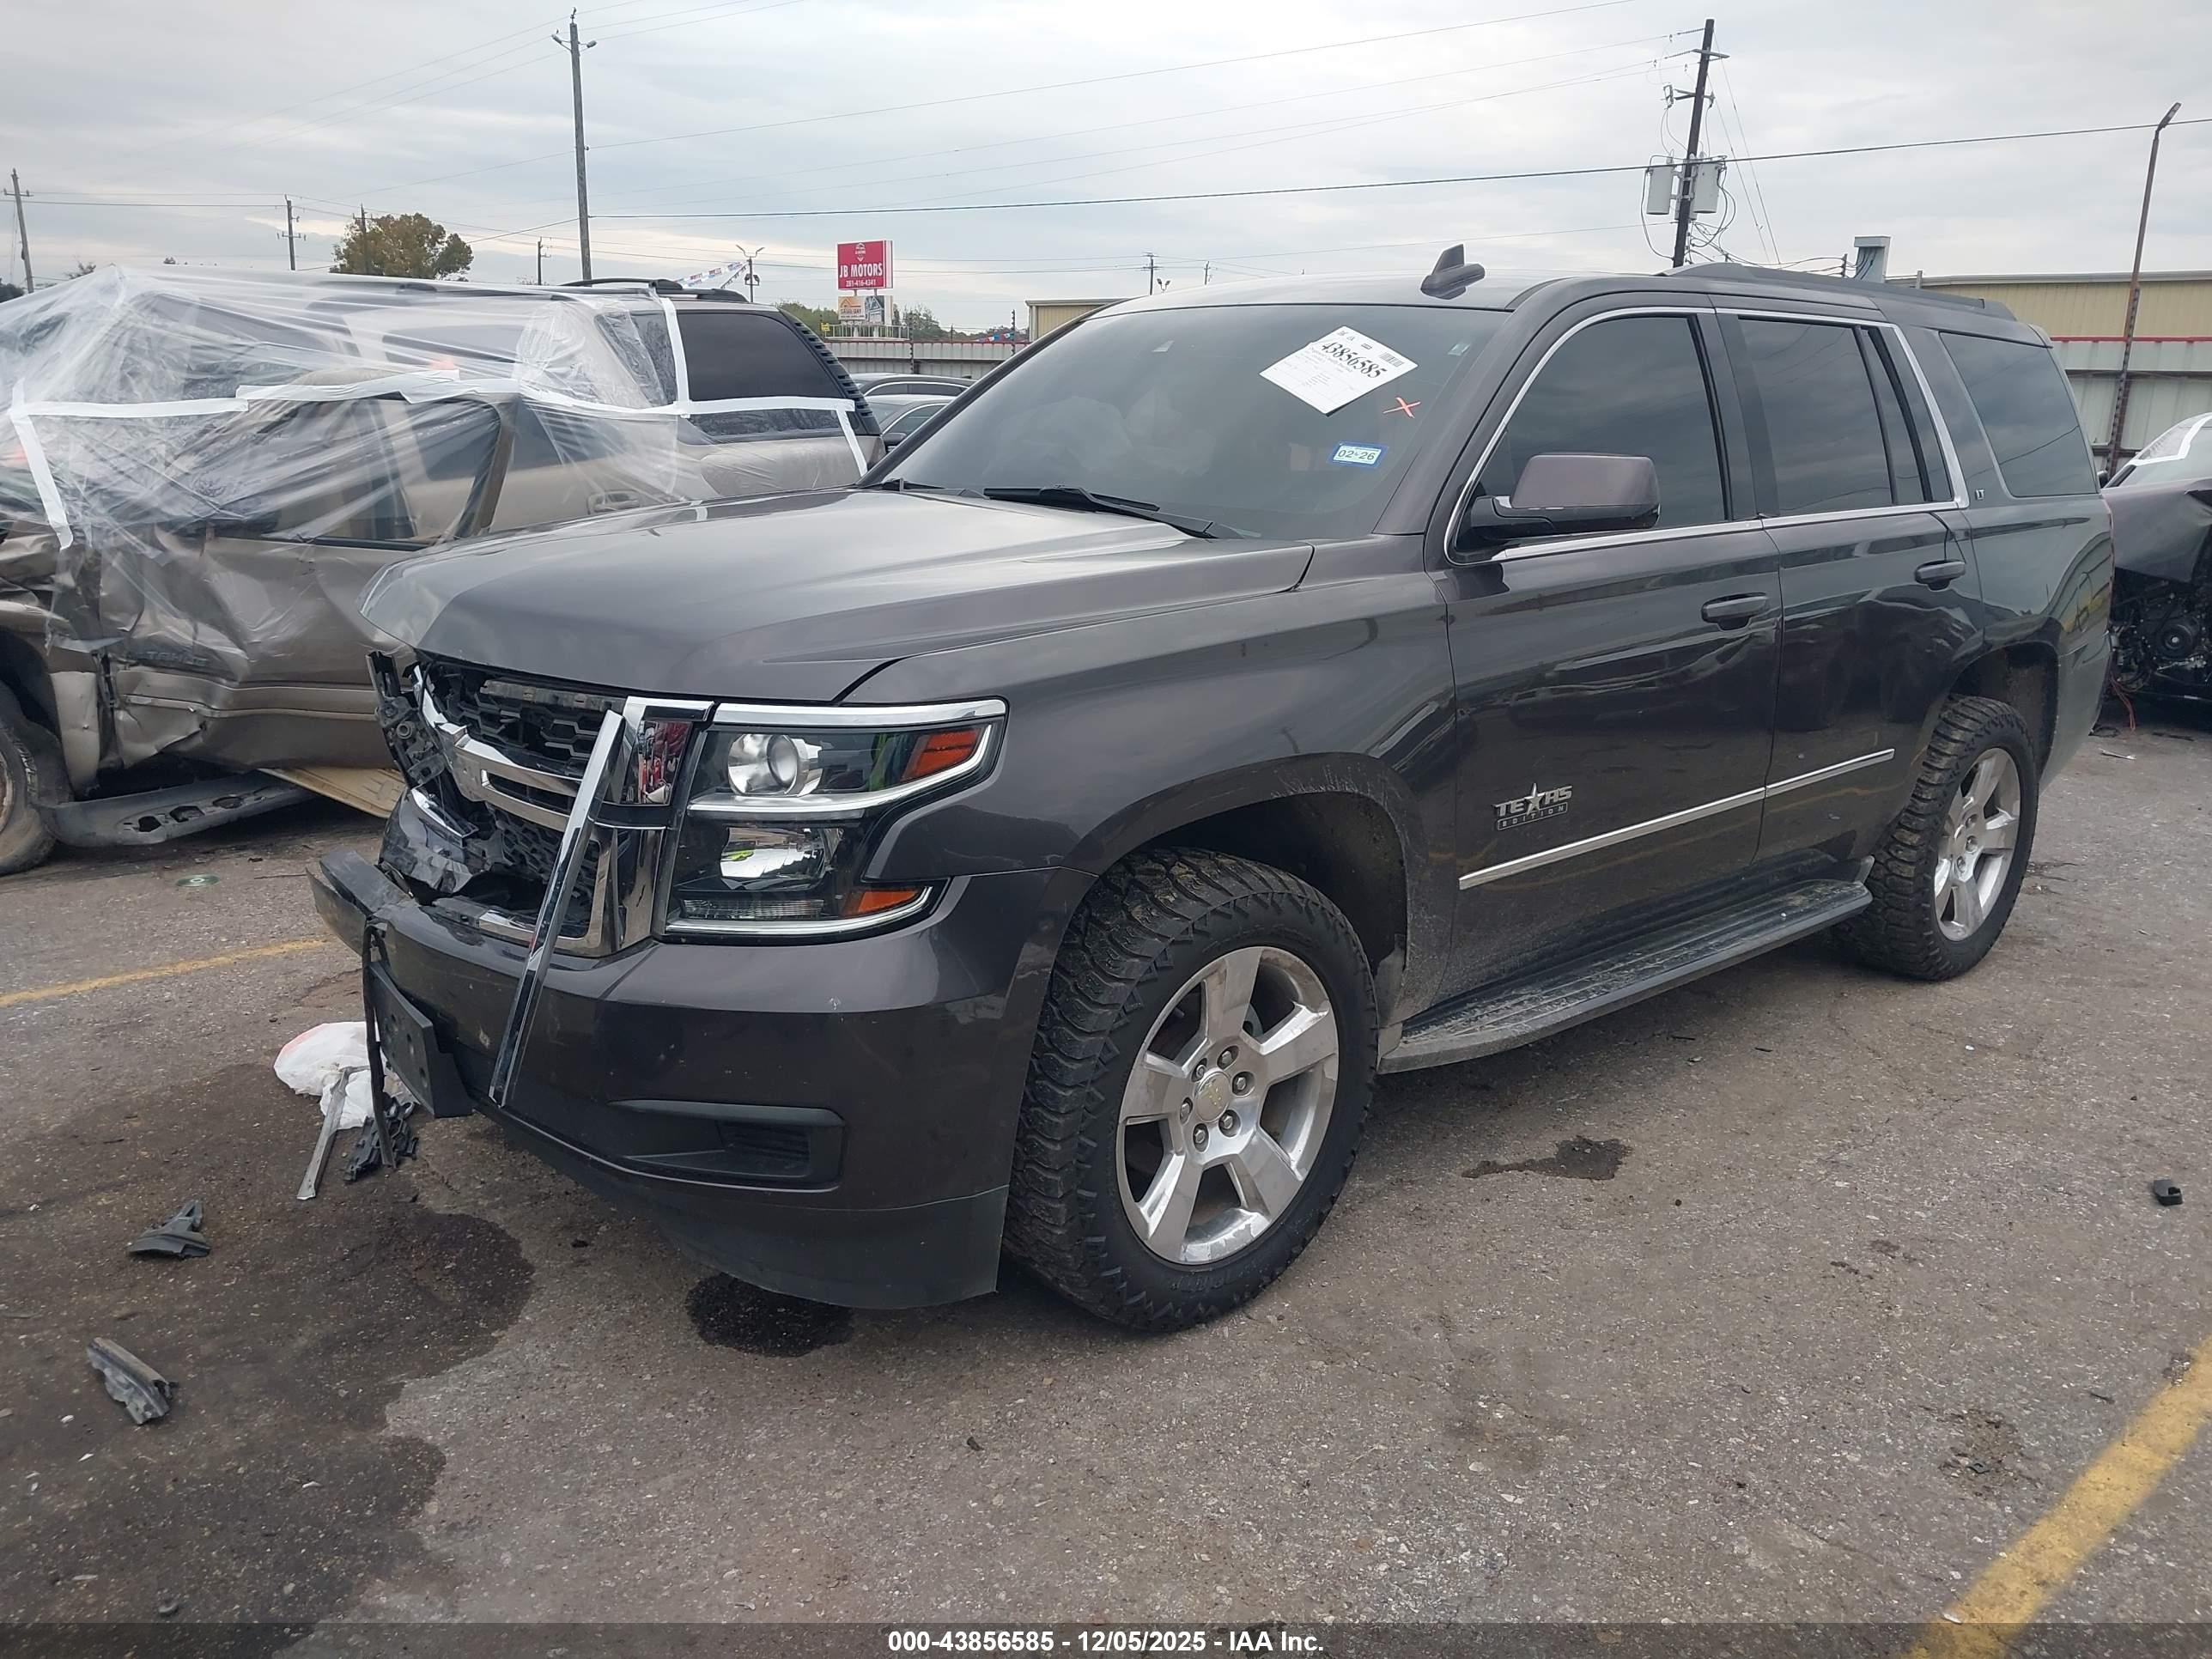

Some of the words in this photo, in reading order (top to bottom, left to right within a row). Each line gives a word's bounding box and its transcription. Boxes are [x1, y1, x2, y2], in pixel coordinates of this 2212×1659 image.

[839, 264, 848, 278] JB
[850, 262, 883, 277] MOTORS
[1322, 342, 1388, 379] 43856585
[1495, 783, 1572, 817] TEXAS
[1502, 805, 1564, 827] EDITION
